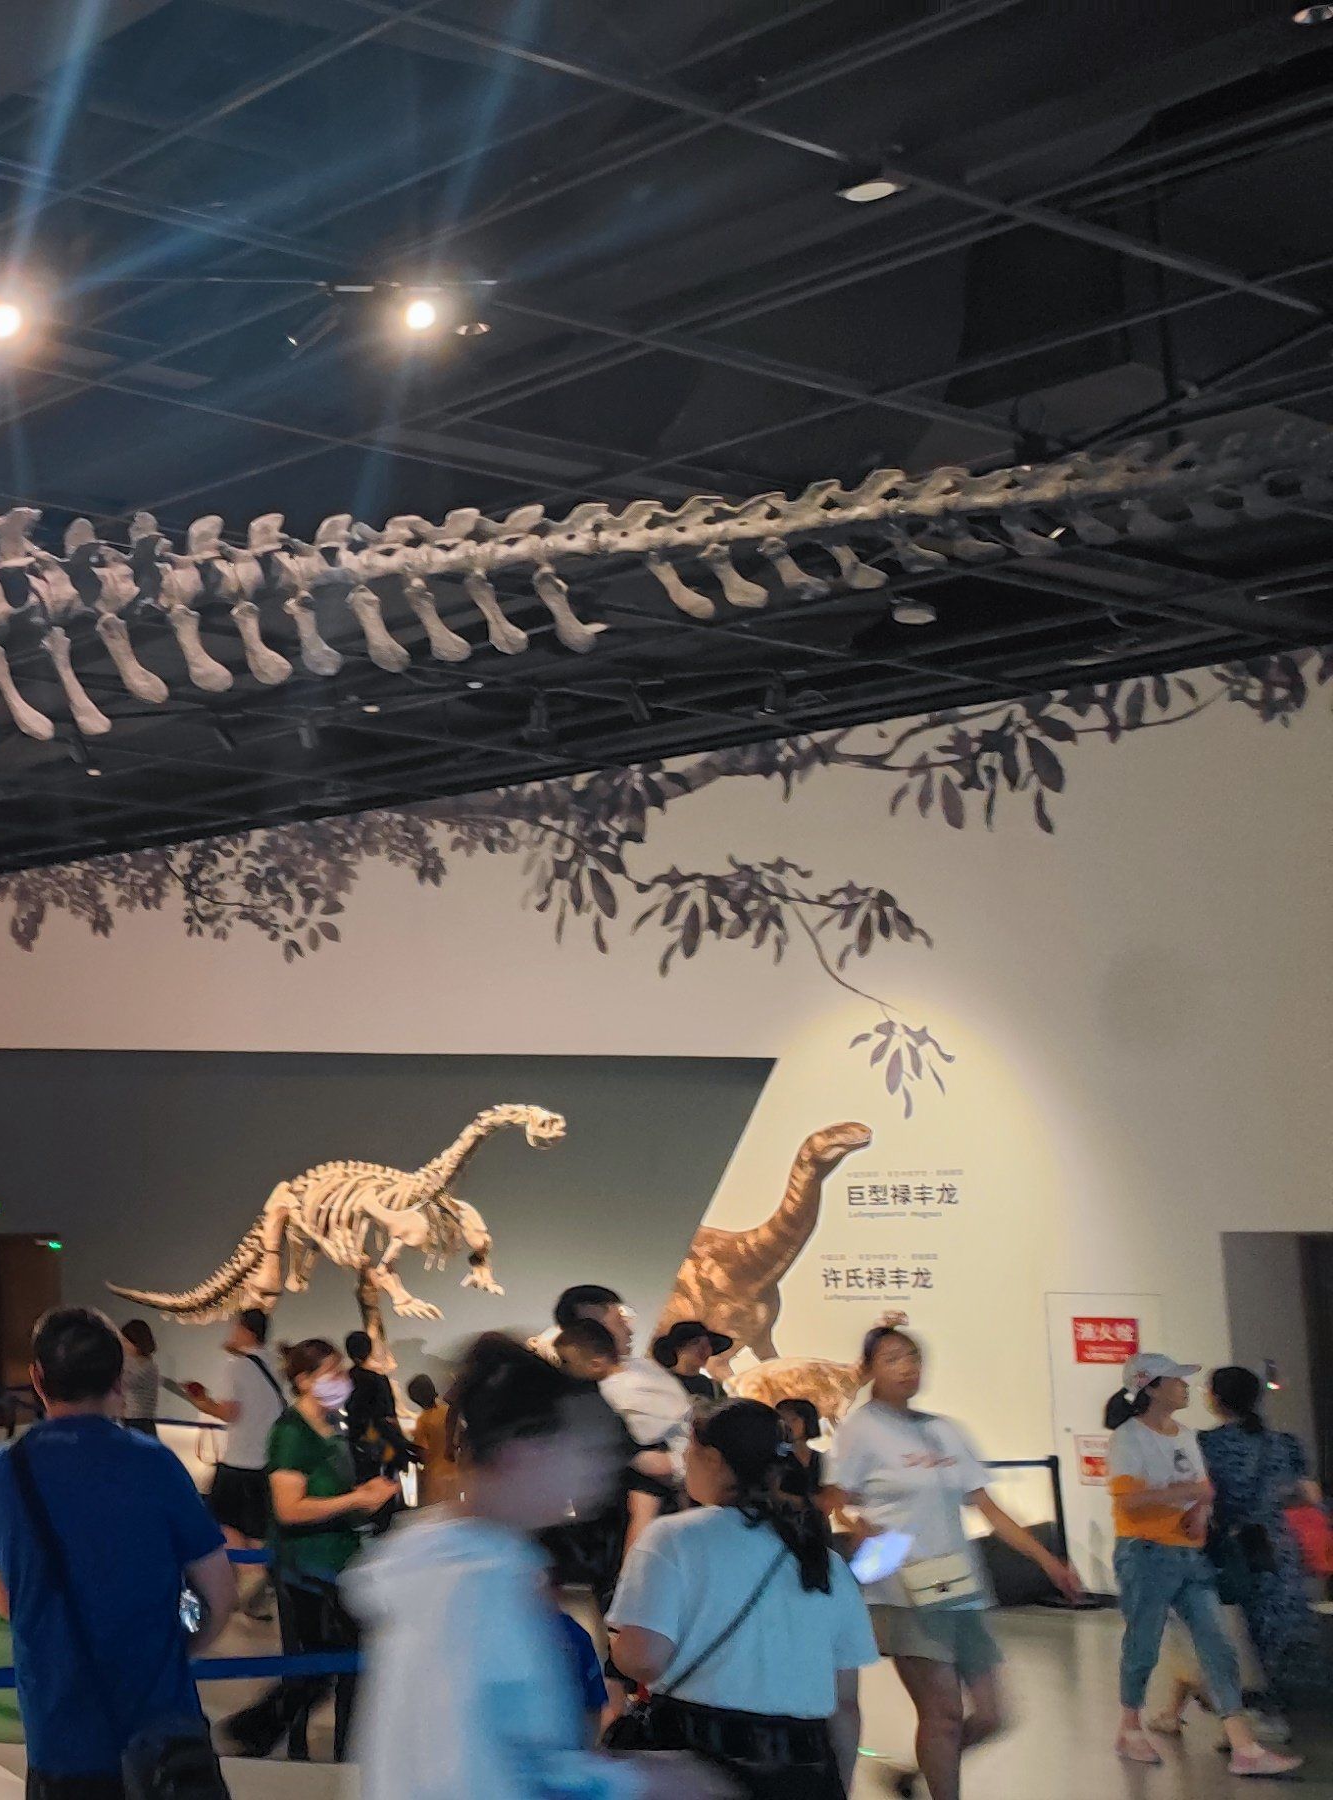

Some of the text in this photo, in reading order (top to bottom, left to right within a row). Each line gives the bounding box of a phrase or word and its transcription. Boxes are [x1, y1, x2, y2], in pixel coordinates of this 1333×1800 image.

[847, 1182, 959, 1206] 巨型禄丰龙
[821, 1266, 934, 1289] 许氏禄丰龙
